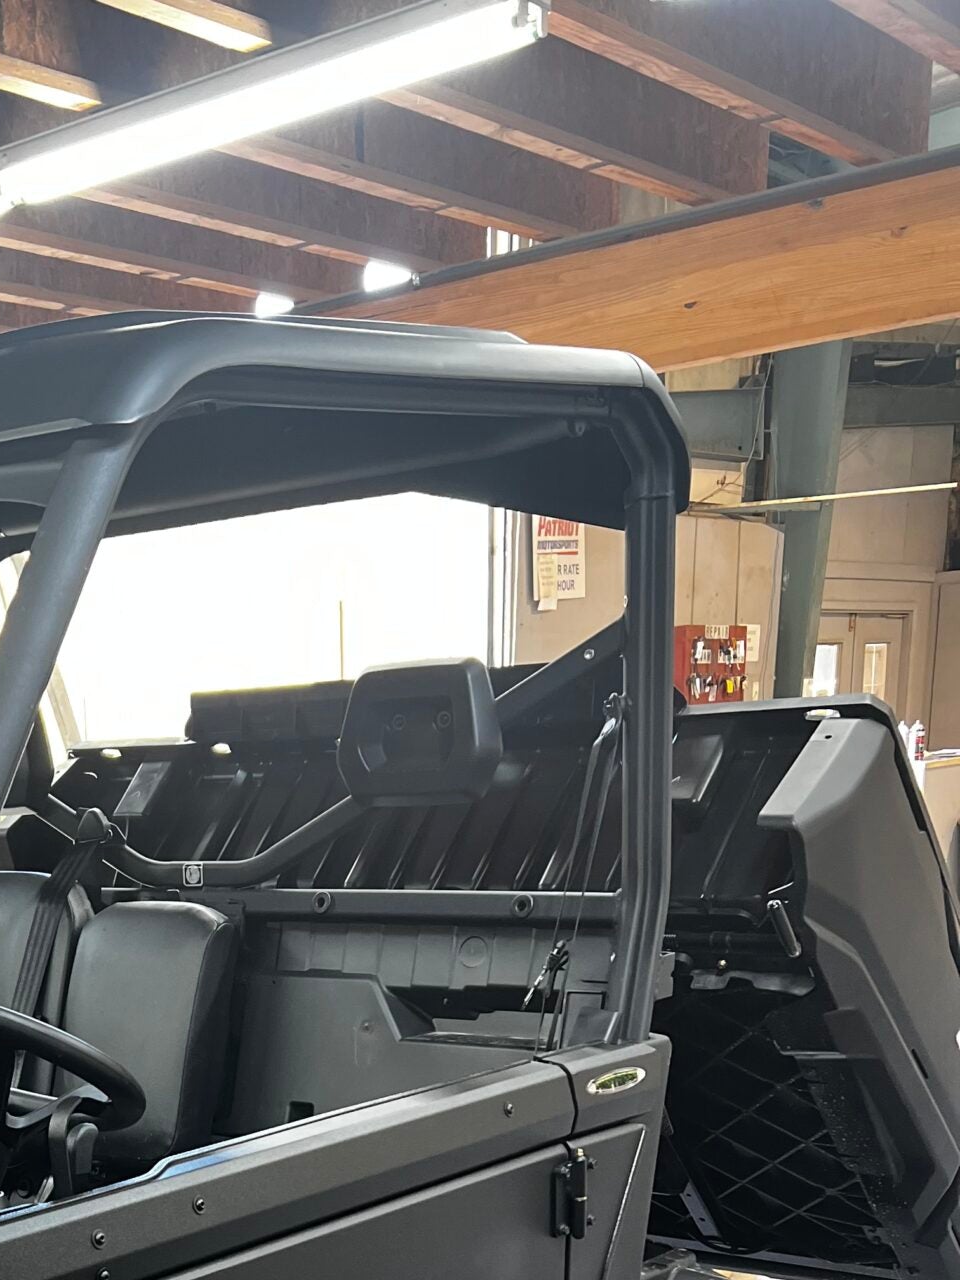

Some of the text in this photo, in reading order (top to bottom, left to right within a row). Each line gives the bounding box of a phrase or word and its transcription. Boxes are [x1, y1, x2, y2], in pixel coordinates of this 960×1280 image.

[537, 517, 580, 536] PATRIOT
[537, 540, 579, 550] MOTORSPORTS
[564, 564, 580, 575] RATE
[557, 580, 575, 591] HOUR
[706, 625, 728, 637] REPAIR
